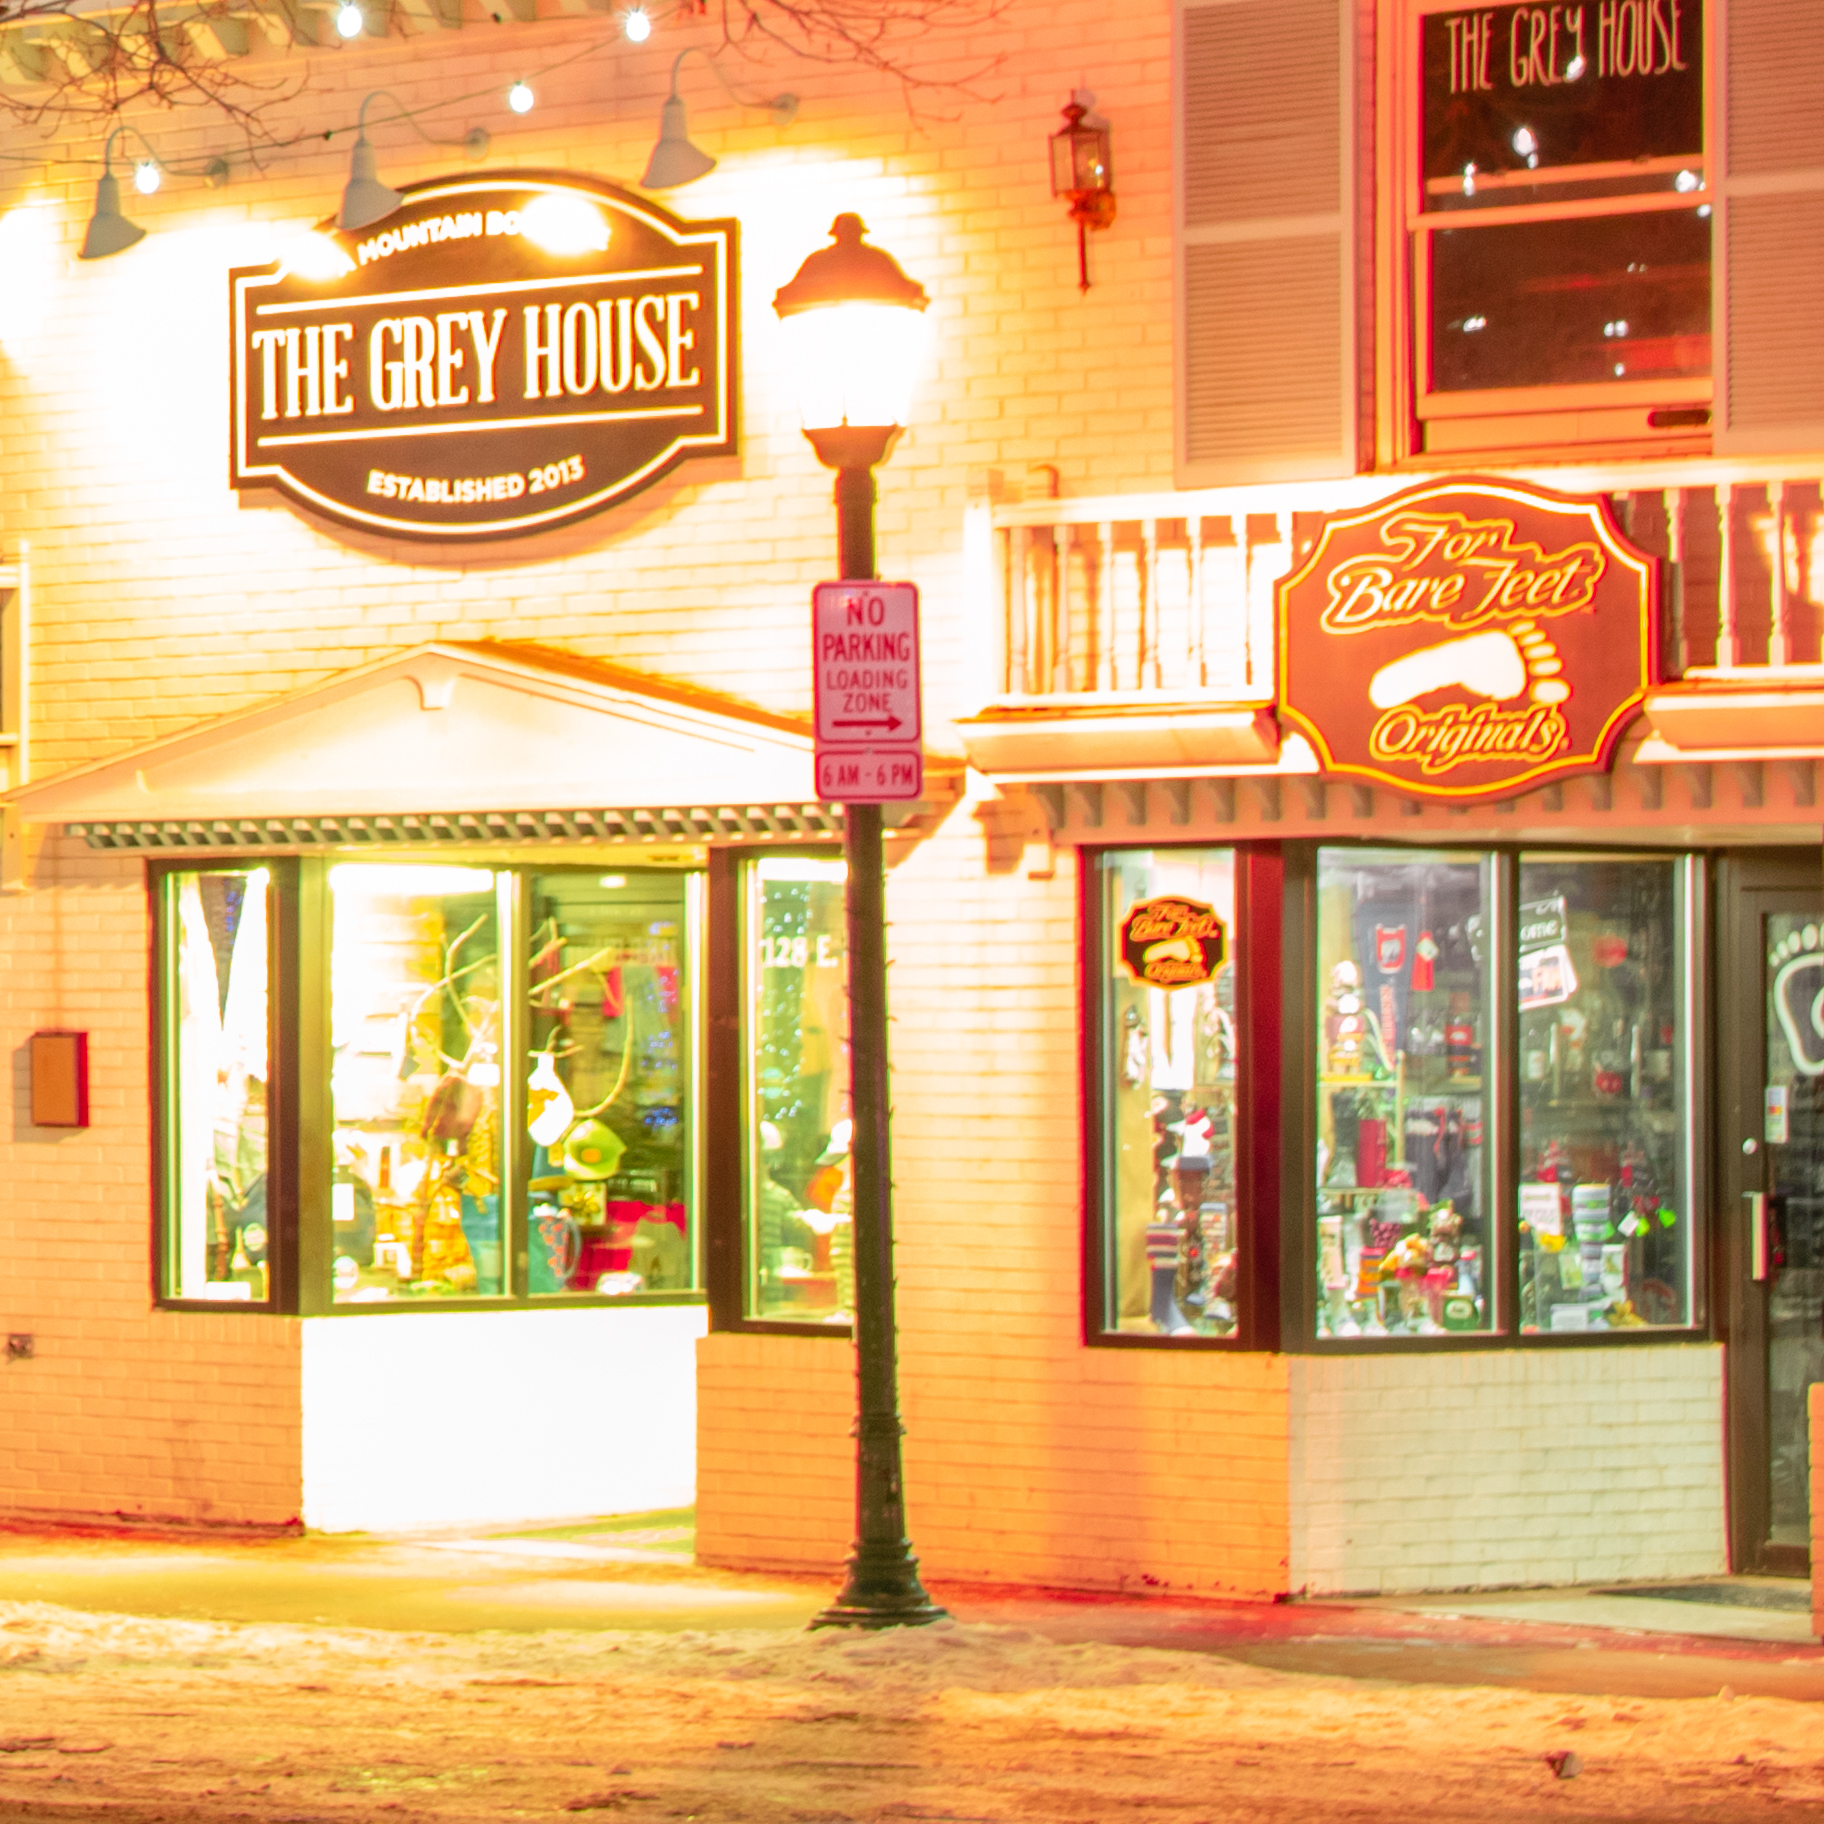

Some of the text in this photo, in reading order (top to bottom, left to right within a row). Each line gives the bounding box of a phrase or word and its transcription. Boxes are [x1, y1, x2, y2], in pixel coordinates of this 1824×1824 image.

[1445, 12, 1494, 94] THE
[1510, 5, 1585, 88] GREY
[357, 212, 484, 266] MOUNTAIN
[252, 292, 701, 420] THE GREY HOUSE
[366, 454, 586, 504] ESTABLISHED 2013
[1400, 523, 1500, 572] For
[846, 595, 886, 627] NO
[1333, 556, 1588, 624] Bare Feet
[823, 632, 910, 663] PARKING
[826, 669, 908, 691] LOADING
[842, 692, 893, 713] ZONE
[1377, 709, 1560, 766] Originals
[822, 764, 832, 788] 6
[837, 764, 860, 787] AM
[876, 763, 886, 787] 6
[891, 761, 914, 784] PM
[758, 935, 809, 969] 128
